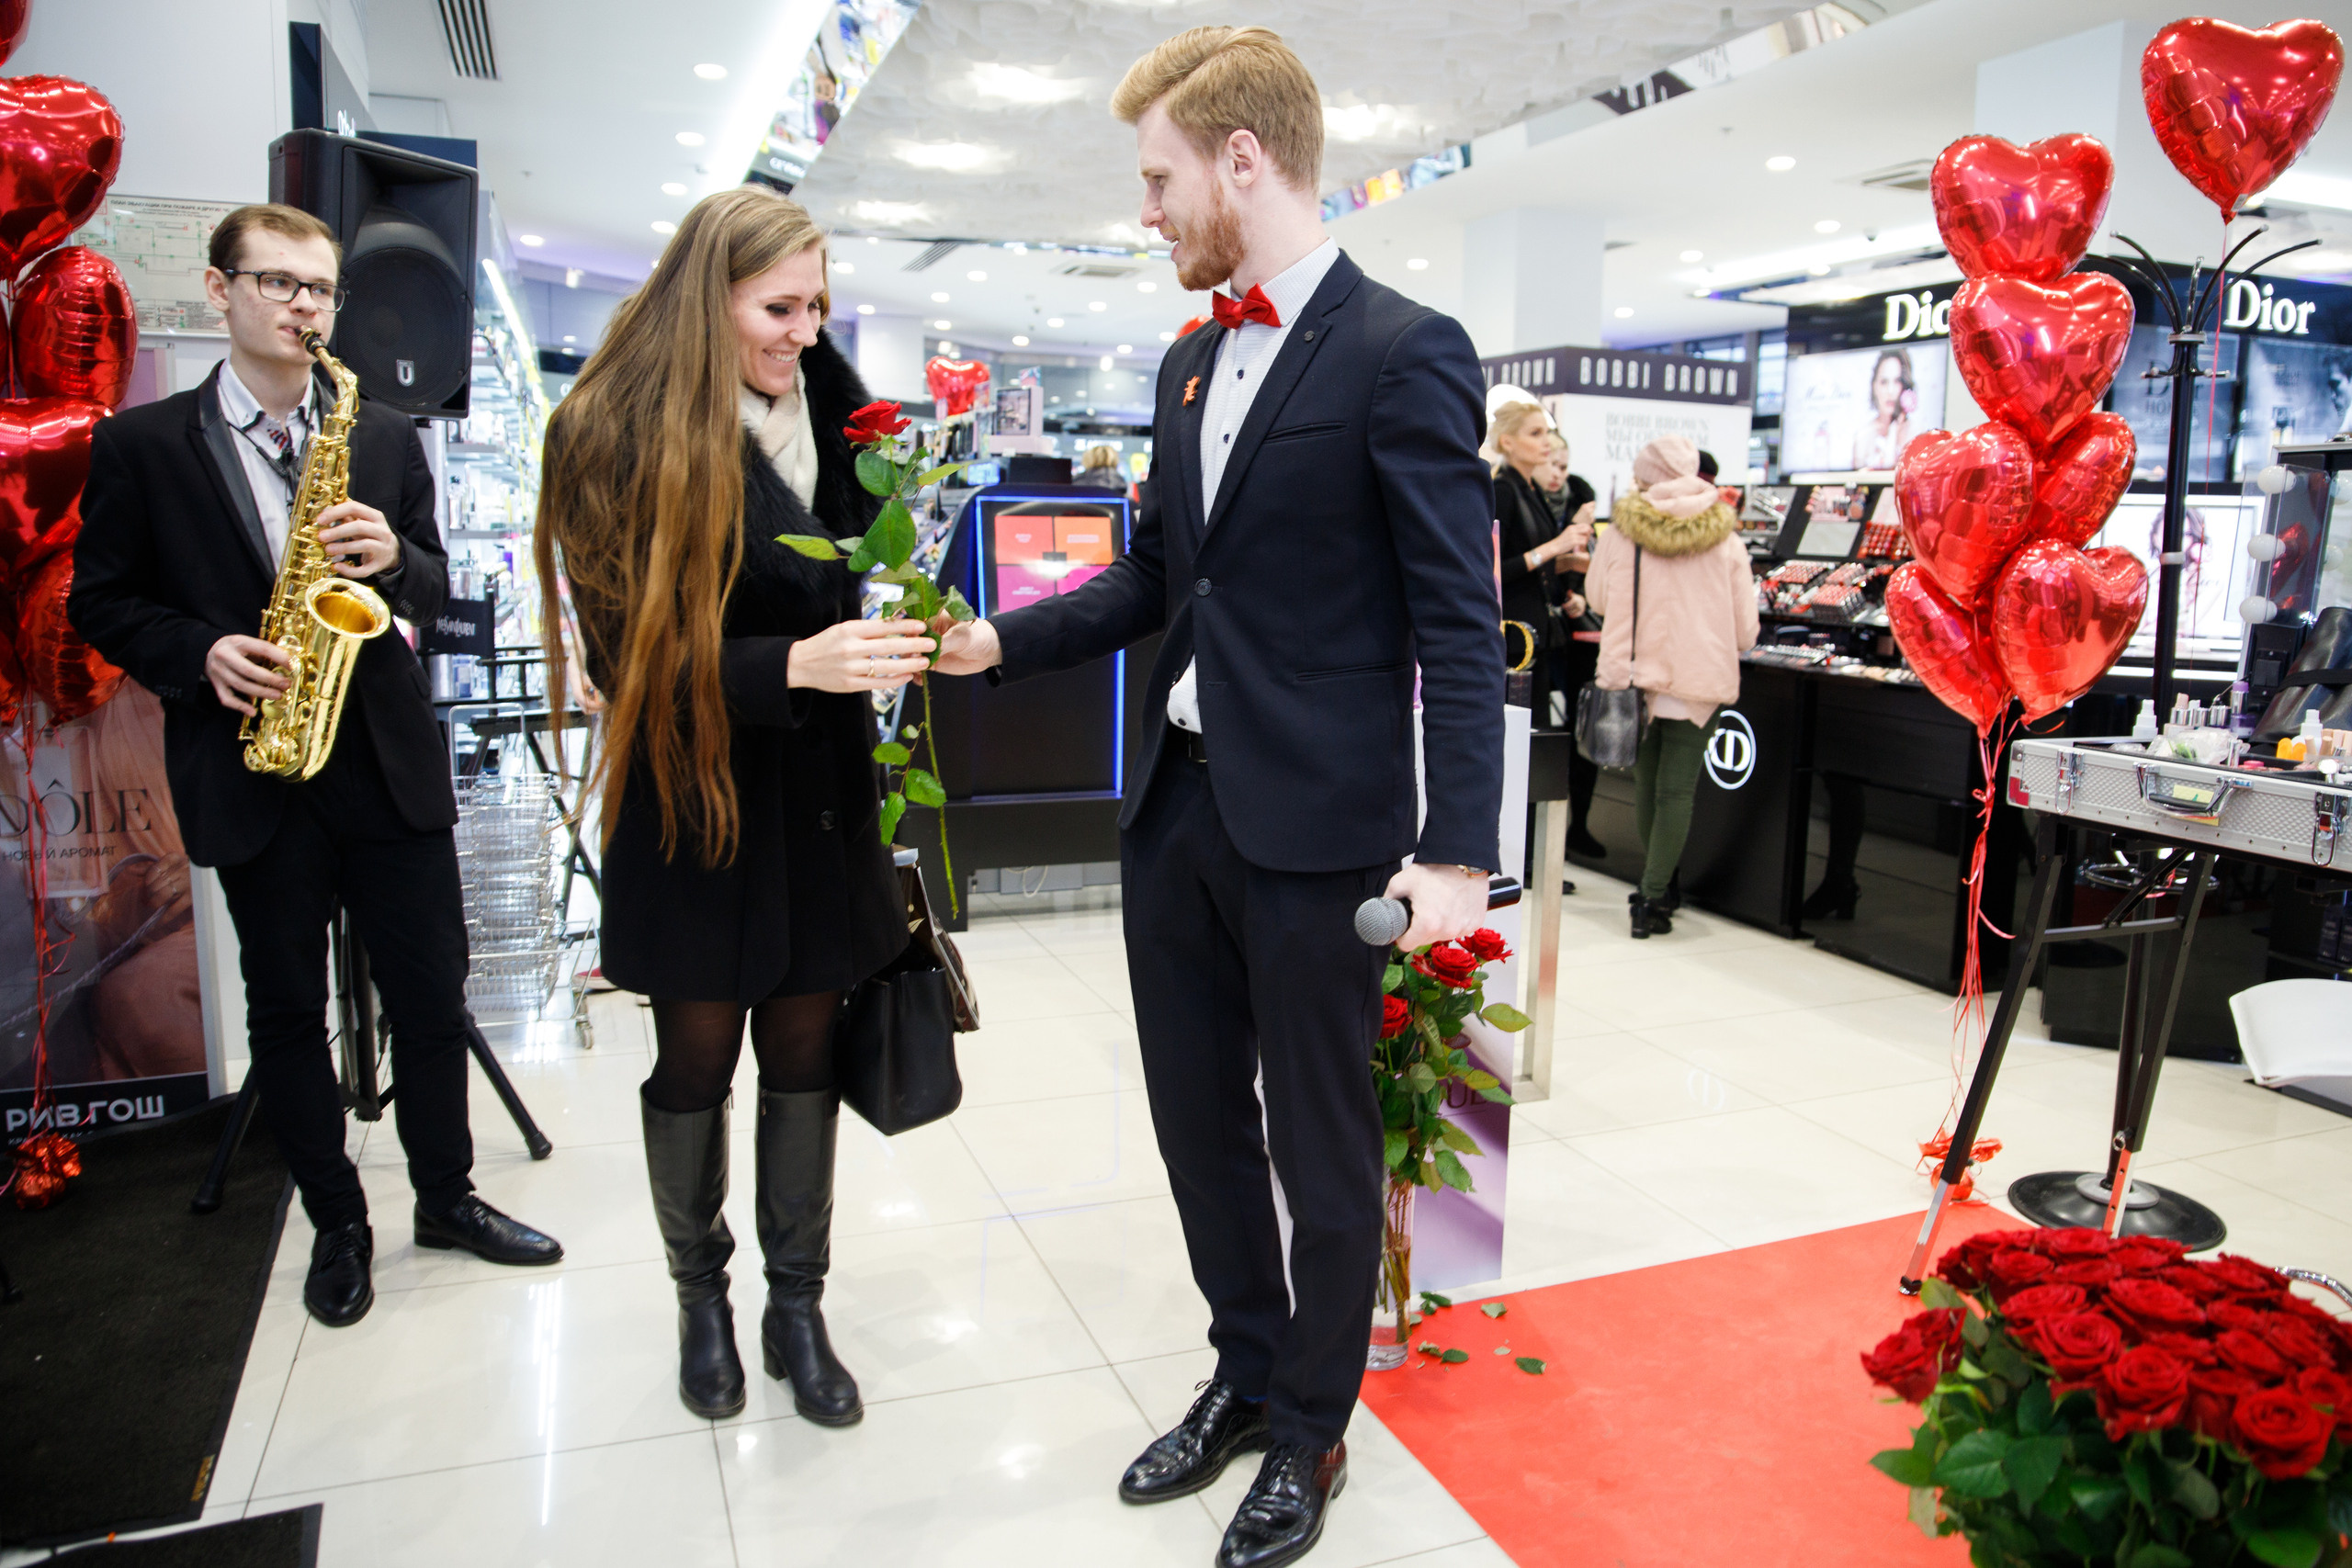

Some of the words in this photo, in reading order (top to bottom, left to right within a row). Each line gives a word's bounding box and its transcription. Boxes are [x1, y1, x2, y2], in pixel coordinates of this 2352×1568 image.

[1883, 290, 1951, 341] Dio
[2223, 278, 2316, 334] Dior
[1580, 356, 1650, 389] BOBBI
[1665, 364, 1738, 396] BROWN
[60, 846, 117, 860] АРОМАТ
[6, 1104, 81, 1133] РИВ
[88, 1095, 164, 1125] ГОШ
